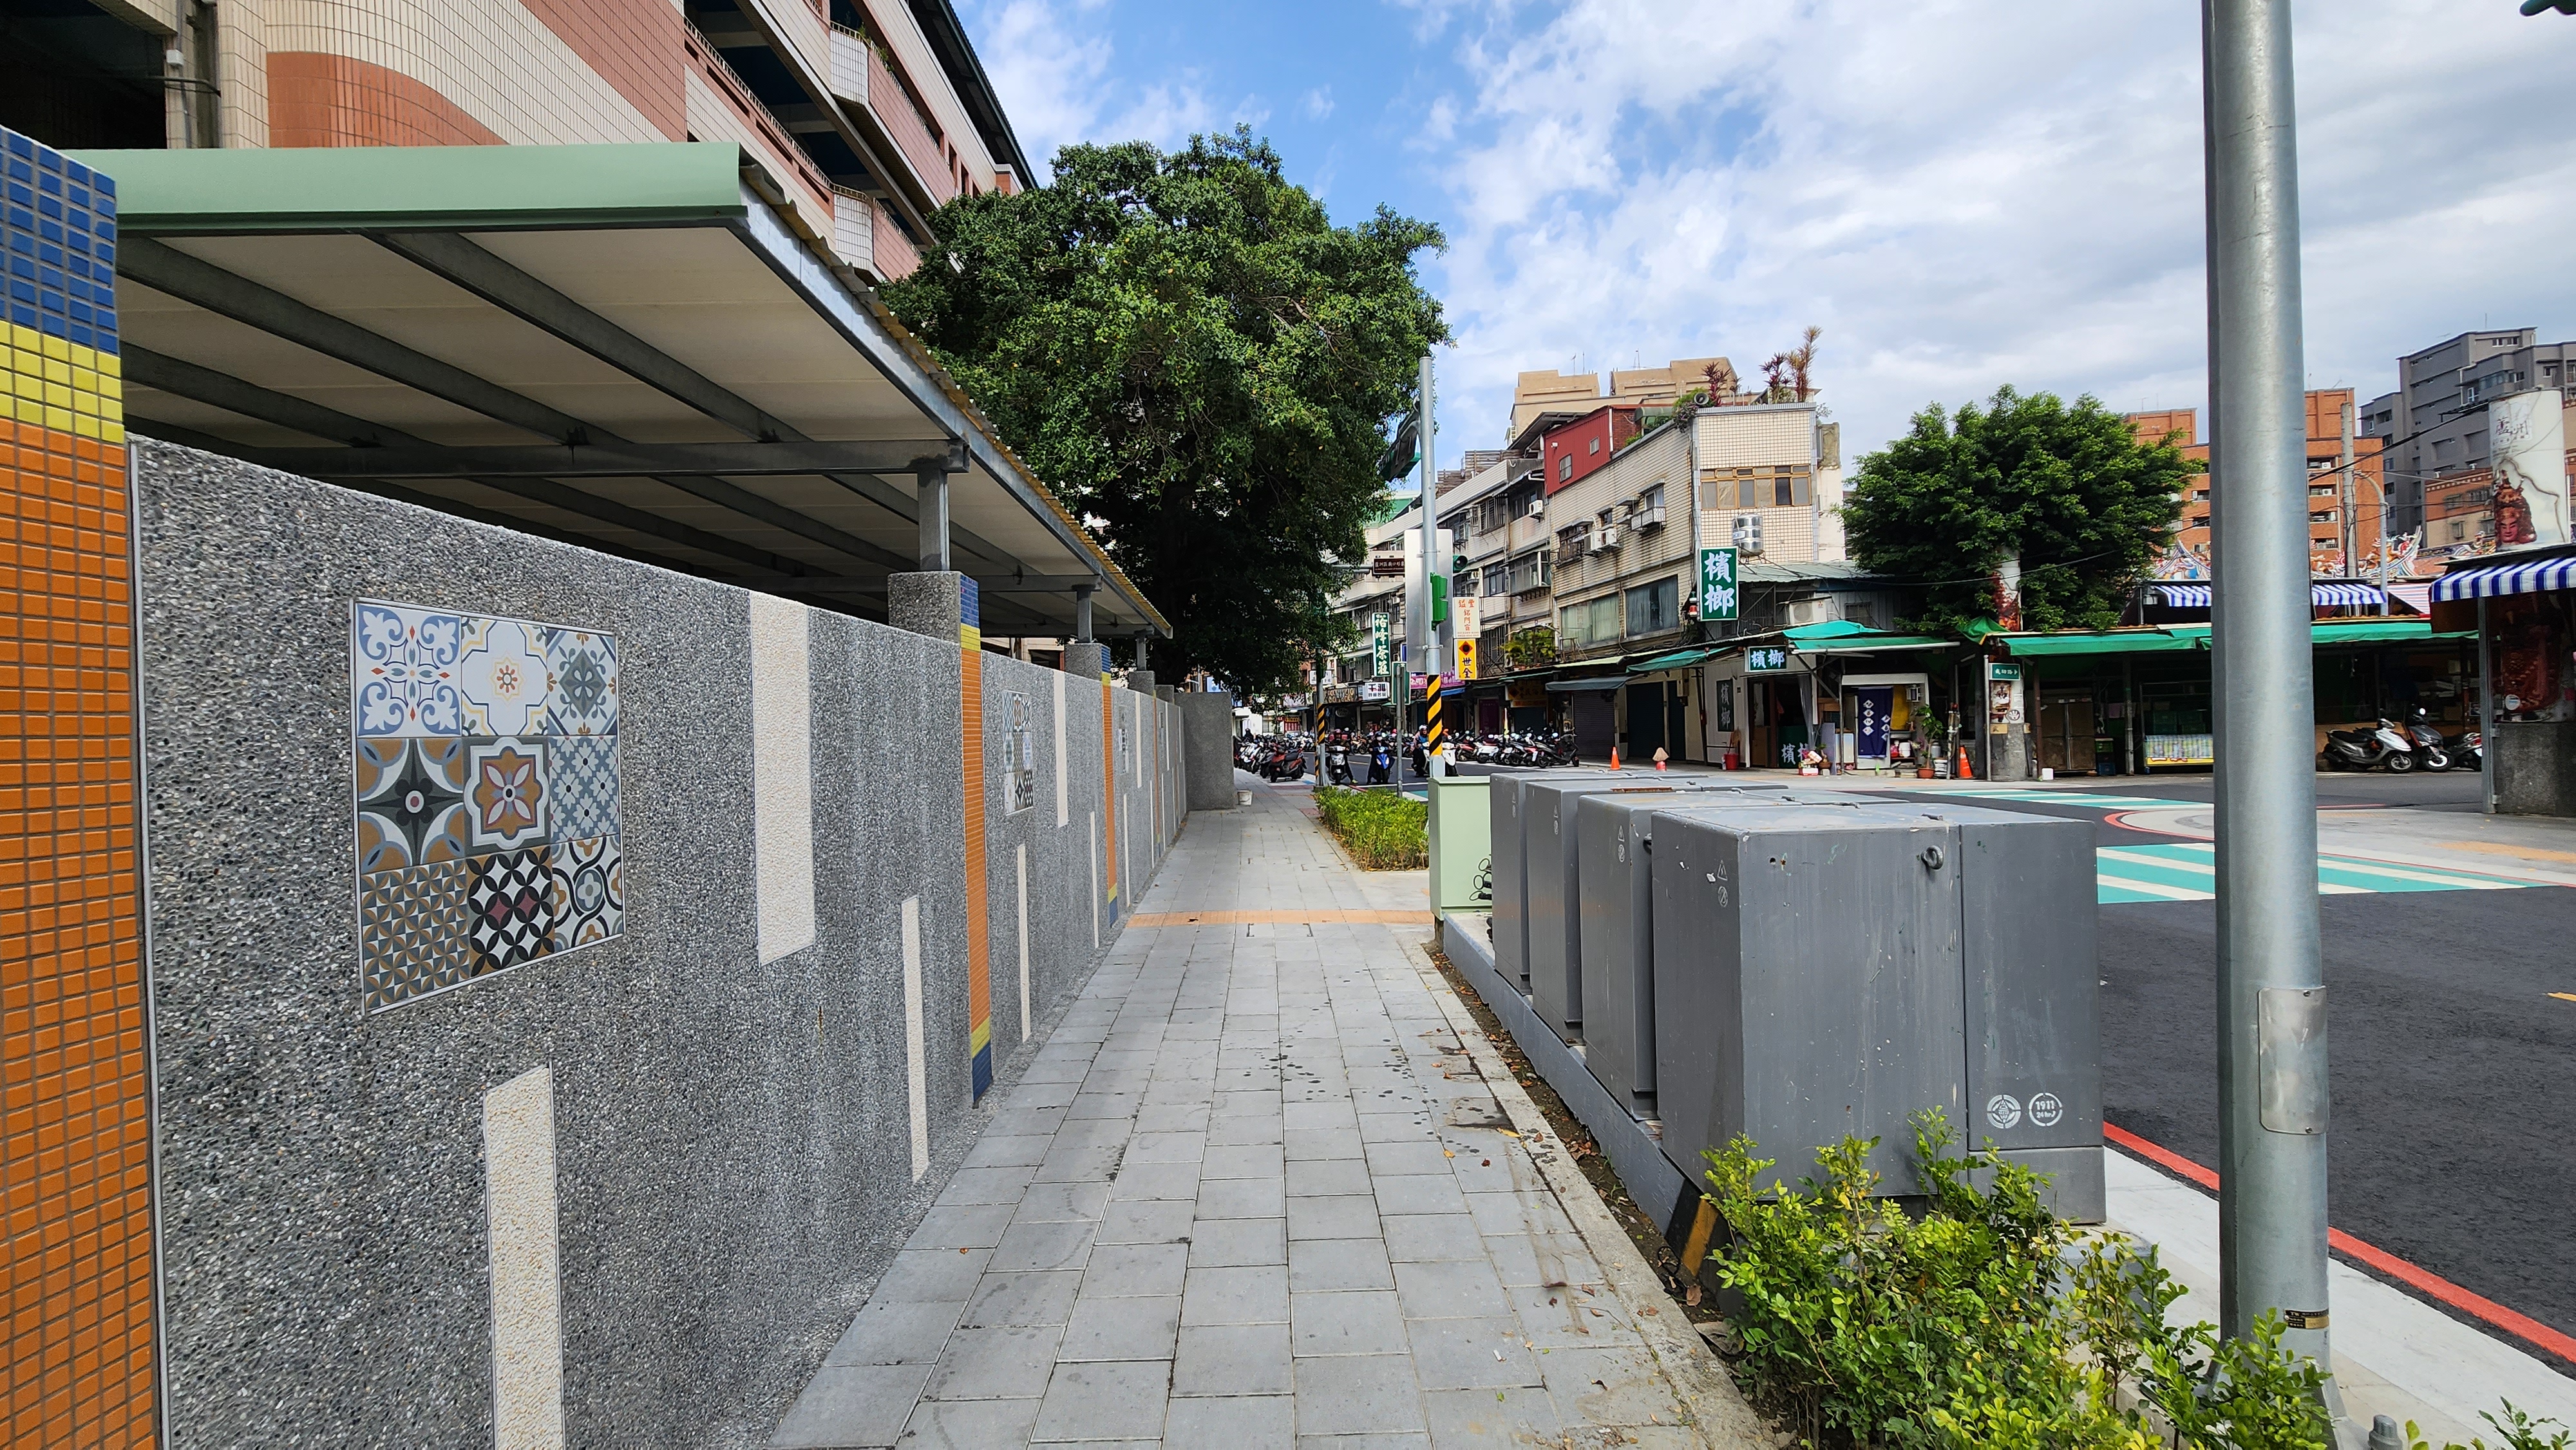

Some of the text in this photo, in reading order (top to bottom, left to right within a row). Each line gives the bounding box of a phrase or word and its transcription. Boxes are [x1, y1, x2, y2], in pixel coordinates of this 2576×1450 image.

[1704, 551, 1735, 616] 檳榔
[1462, 657, 1473, 678] 世全
[1751, 649, 1785, 668] 檳榔
[1721, 683, 1731, 730] 檳榔
[2035, 1100, 2055, 1110] 1911
